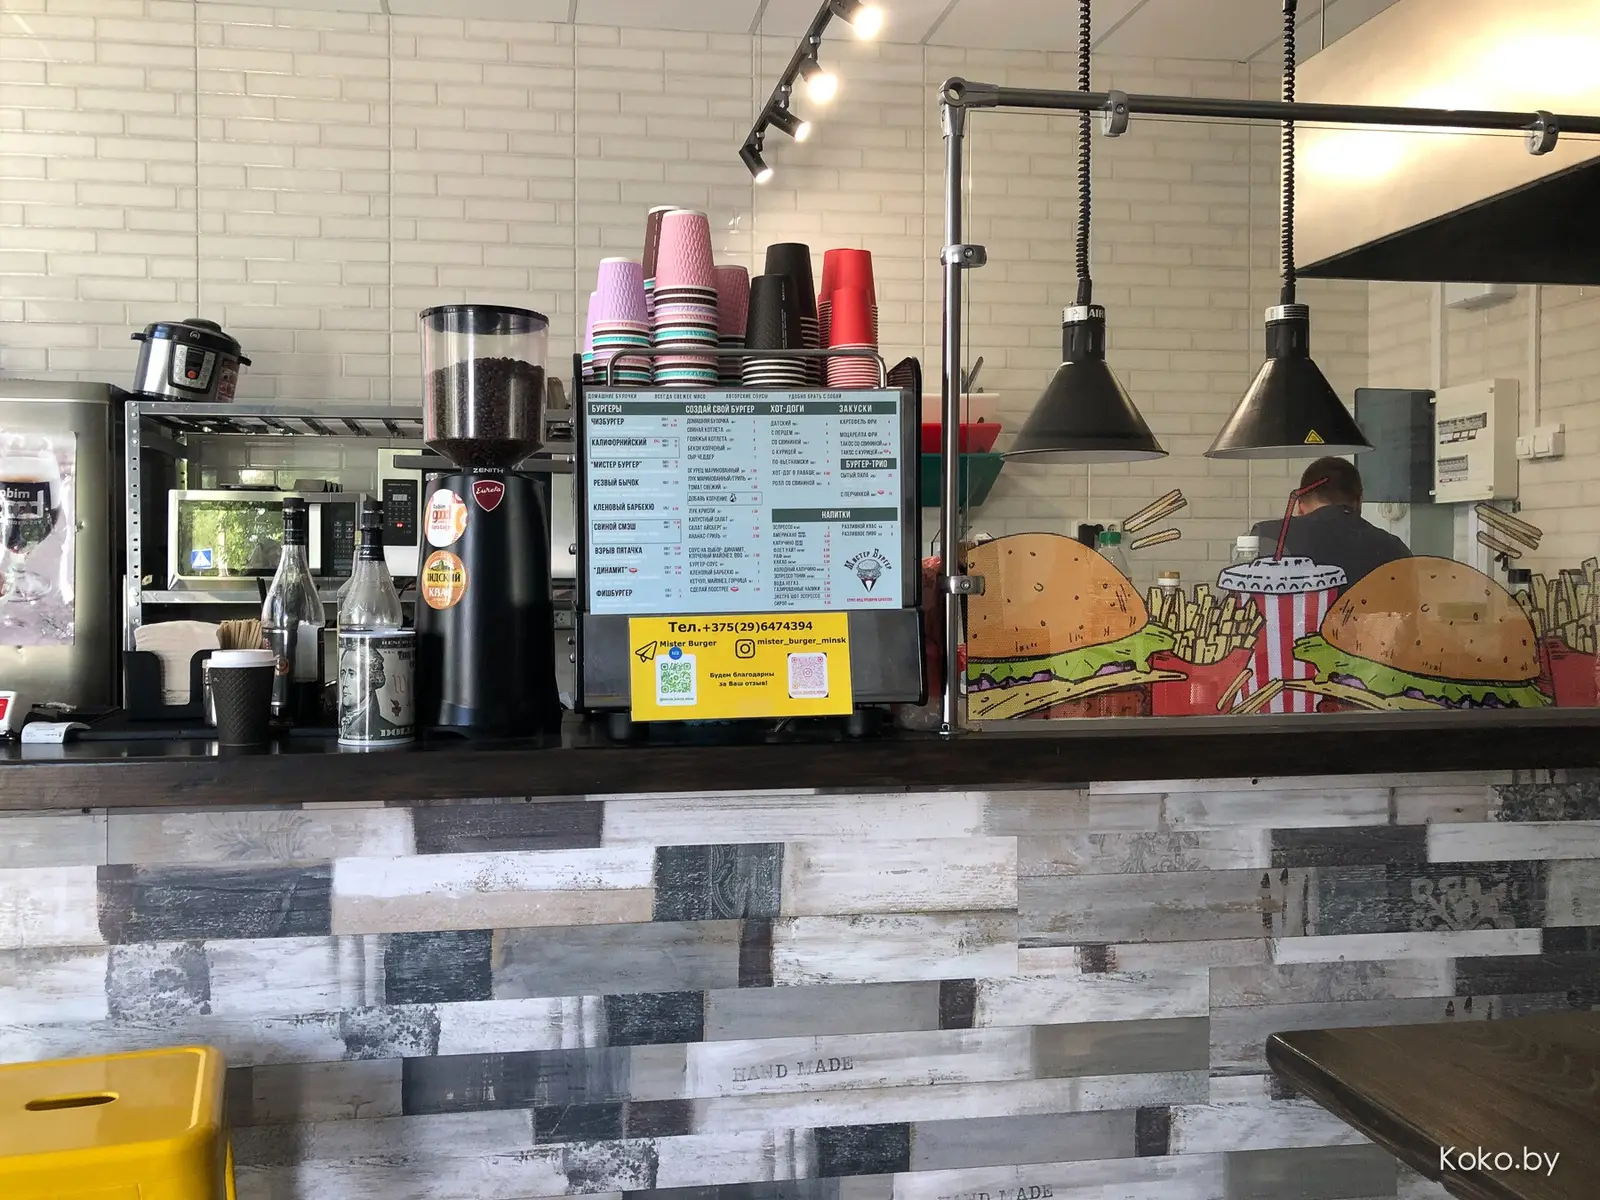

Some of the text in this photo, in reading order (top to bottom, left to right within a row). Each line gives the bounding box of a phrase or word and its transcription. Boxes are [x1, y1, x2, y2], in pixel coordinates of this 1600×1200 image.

[592, 405, 622, 413] БУРГЕРЫ
[685, 404, 755, 414] СОЗДАЙ СВОЙ БУРГЕР
[770, 405, 805, 413] ХОТ-ДОГИ
[839, 405, 872, 413] ЗАКУСКИ
[592, 438, 647, 446] КАЛИФОРНИЙСКИЙ
[846, 460, 888, 468] БУРГЕР-ТРИО
[593, 478, 617, 486] РЕЗВЫЙ
[593, 503, 626, 511] КЛЕНОВЫЙ
[627, 503, 655, 511] БАРБЕКЮ
[822, 511, 850, 519] НАПИТКИ
[594, 521, 617, 530] СВИНОЙ
[596, 589, 632, 597] ФИШБУРГЕР
[689, 640, 717, 648] Burger
[757, 637, 846, 646] mister_burger_minsk
[732, 1056, 853, 1083] HAND MADE
